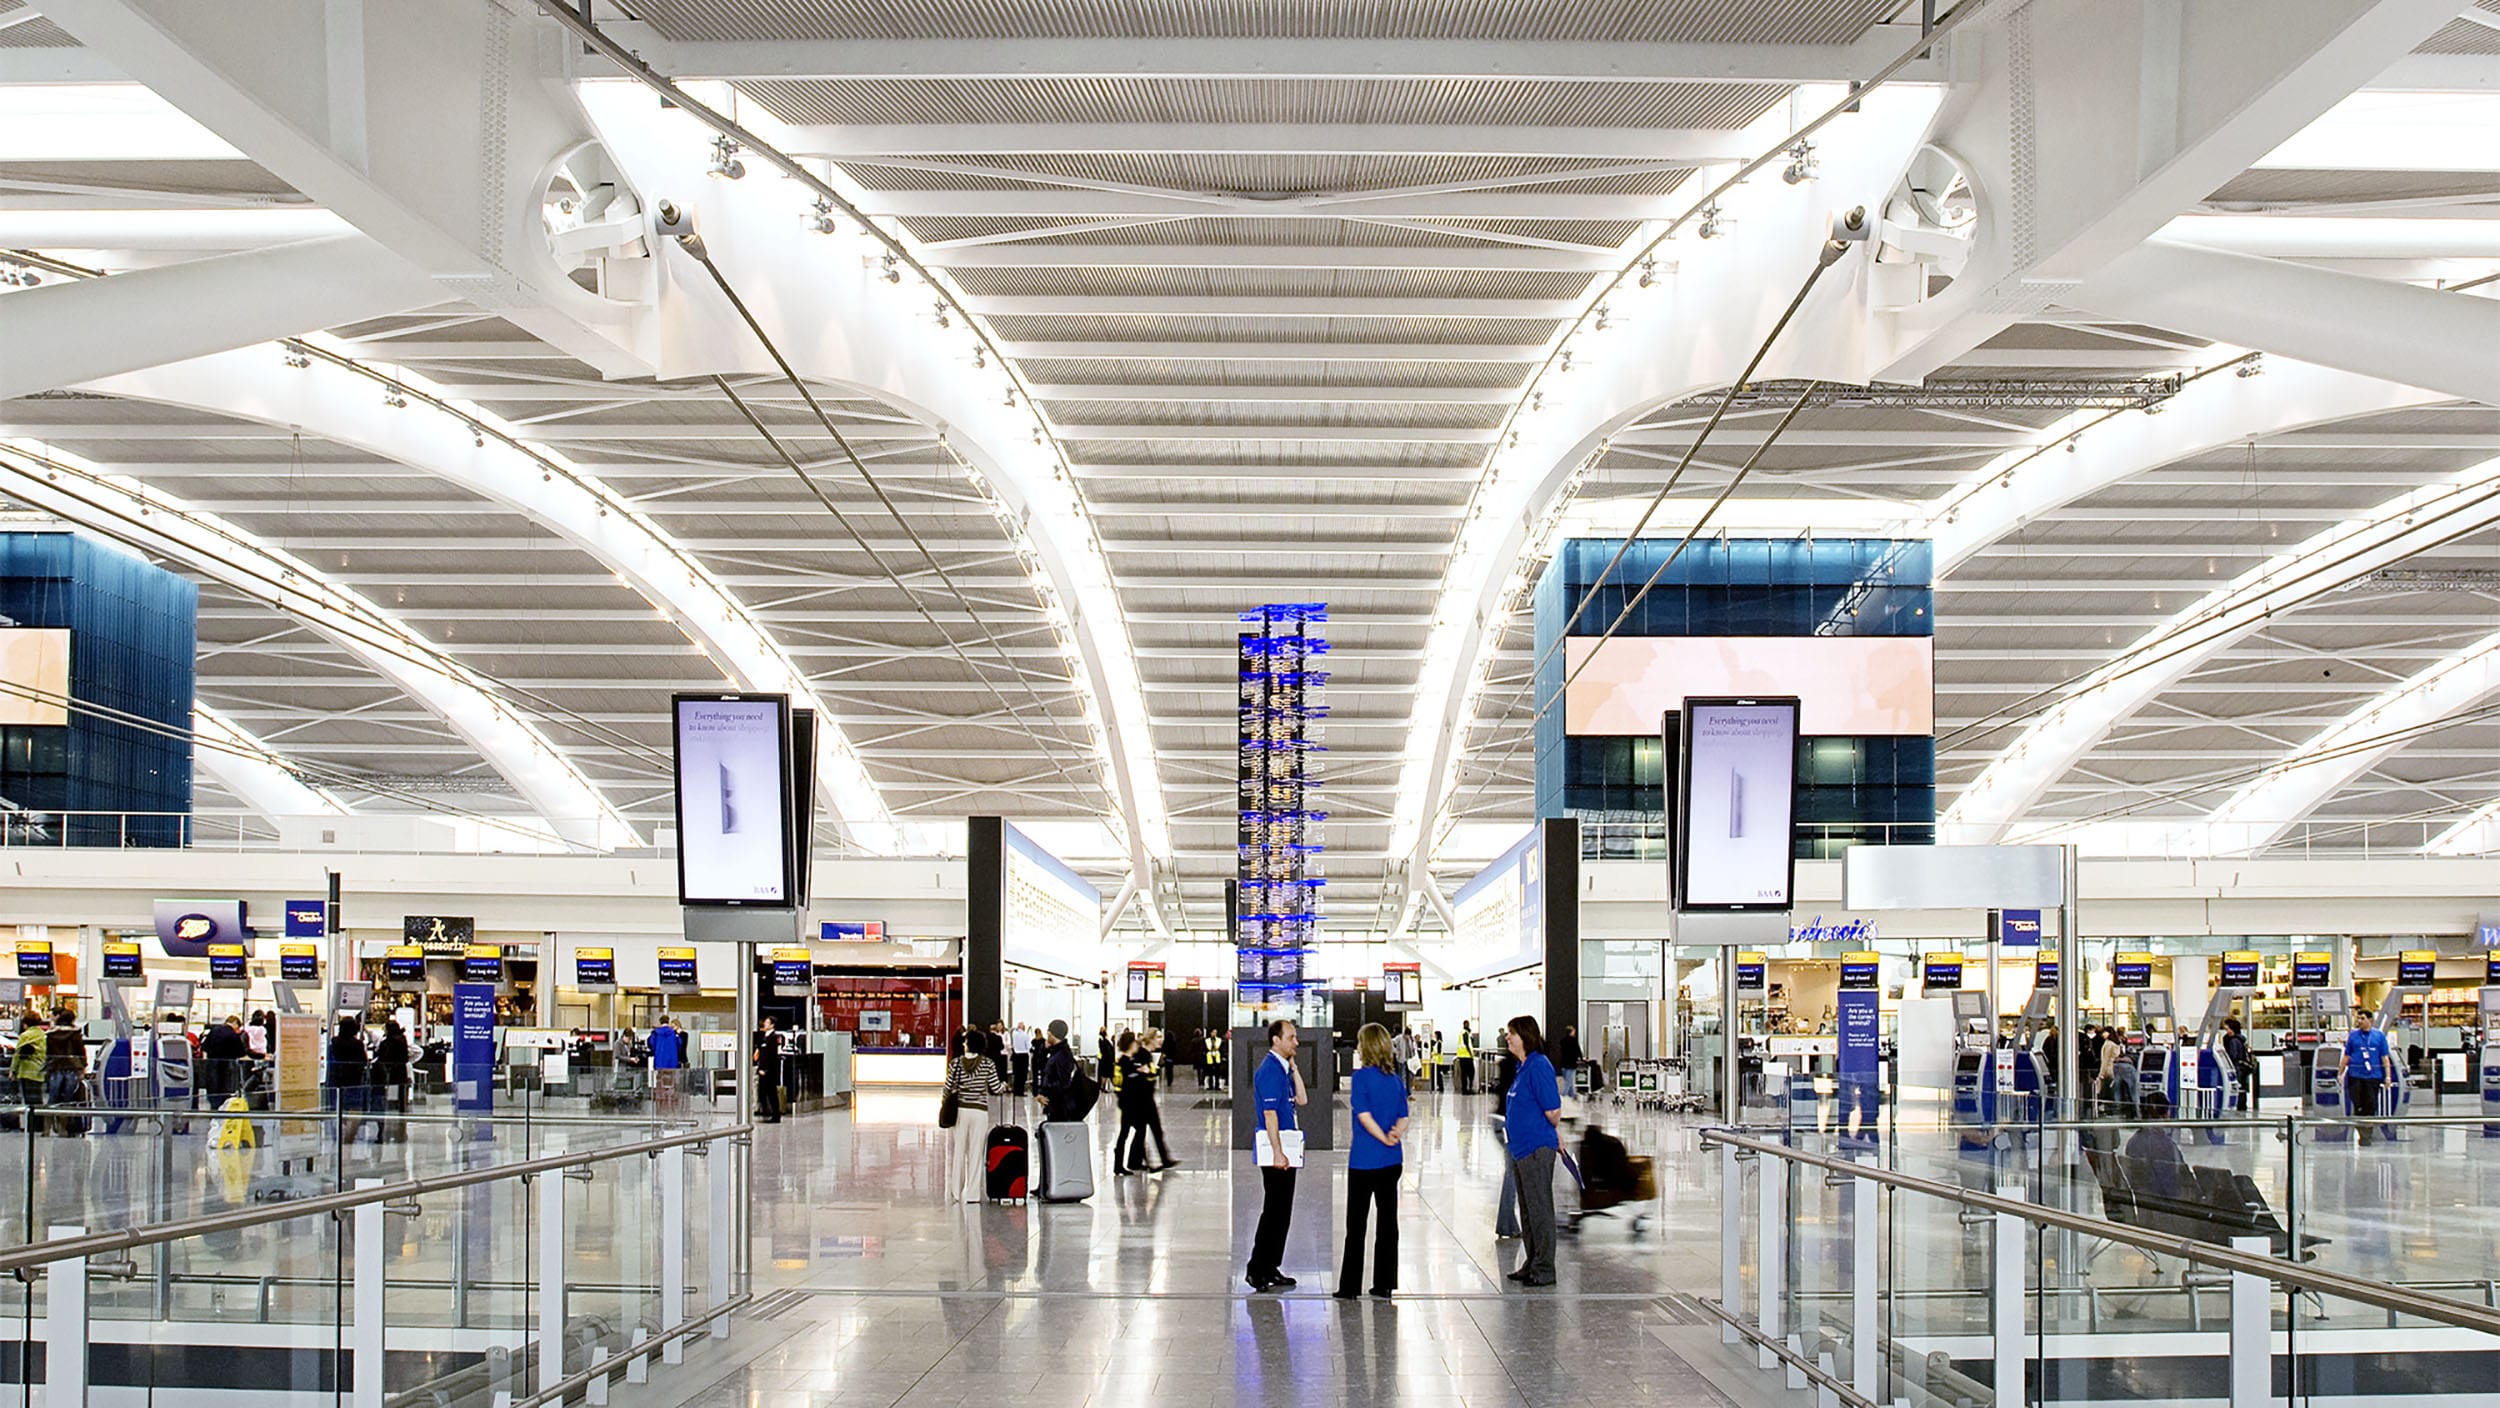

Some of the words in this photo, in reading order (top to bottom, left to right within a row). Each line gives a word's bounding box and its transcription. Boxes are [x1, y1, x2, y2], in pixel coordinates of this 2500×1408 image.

[694, 711, 732, 723] Everything
[732, 714, 744, 723] you
[746, 711, 763, 721] need
[1709, 716, 1747, 727] Everything
[1747, 719, 1760, 727] you
[717, 722, 737, 731] about
